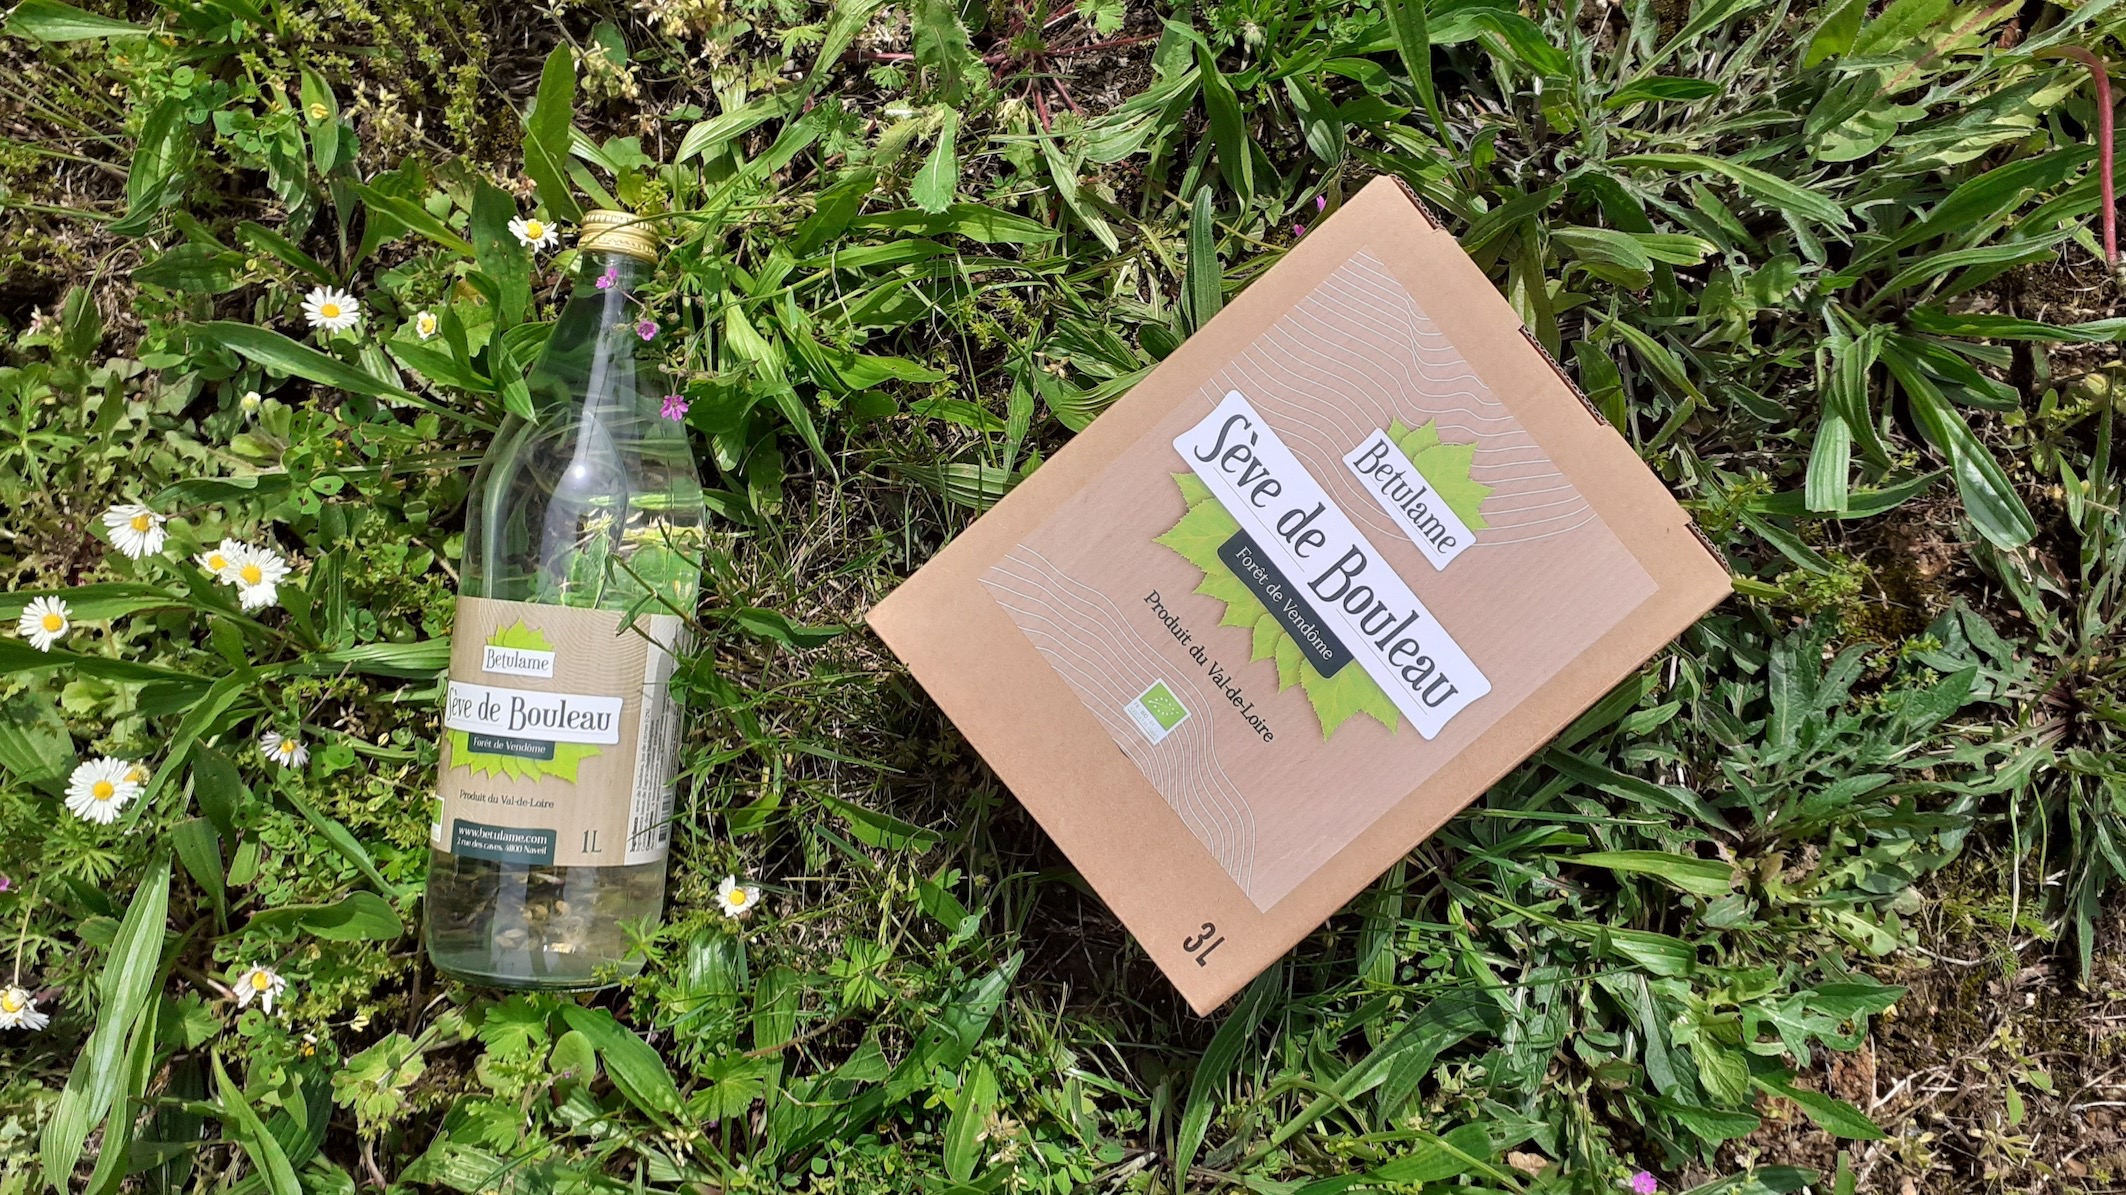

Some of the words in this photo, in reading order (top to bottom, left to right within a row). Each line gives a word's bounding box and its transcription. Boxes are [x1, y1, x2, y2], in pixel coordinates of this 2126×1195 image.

[1353, 438, 1457, 554] Betulame
[1194, 414, 1283, 508] Sève
[1276, 501, 1326, 559] de
[1307, 544, 1459, 709] Bouleau
[1235, 546, 1269, 585] Forêt
[1266, 584, 1283, 602] de
[1282, 598, 1333, 661] Vendôme
[486, 648, 549, 670] Betulame
[1143, 590, 1192, 646] Produit
[1189, 645, 1208, 667] du
[1207, 661, 1274, 743] Val-de-Loire
[447, 686, 473, 722] Sève
[478, 691, 501, 722] de
[507, 695, 612, 731] Bouleau
[472, 736, 493, 749] Forêt
[493, 739, 504, 749] de
[505, 740, 546, 753] Vendôme
[459, 789, 486, 802] Produit
[487, 793, 499, 804] du
[501, 795, 554, 809] Val-de-Loire
[458, 825, 547, 845] www.betulame.com
[581, 829, 602, 854] 1L
[1183, 922, 1225, 968] 3L
